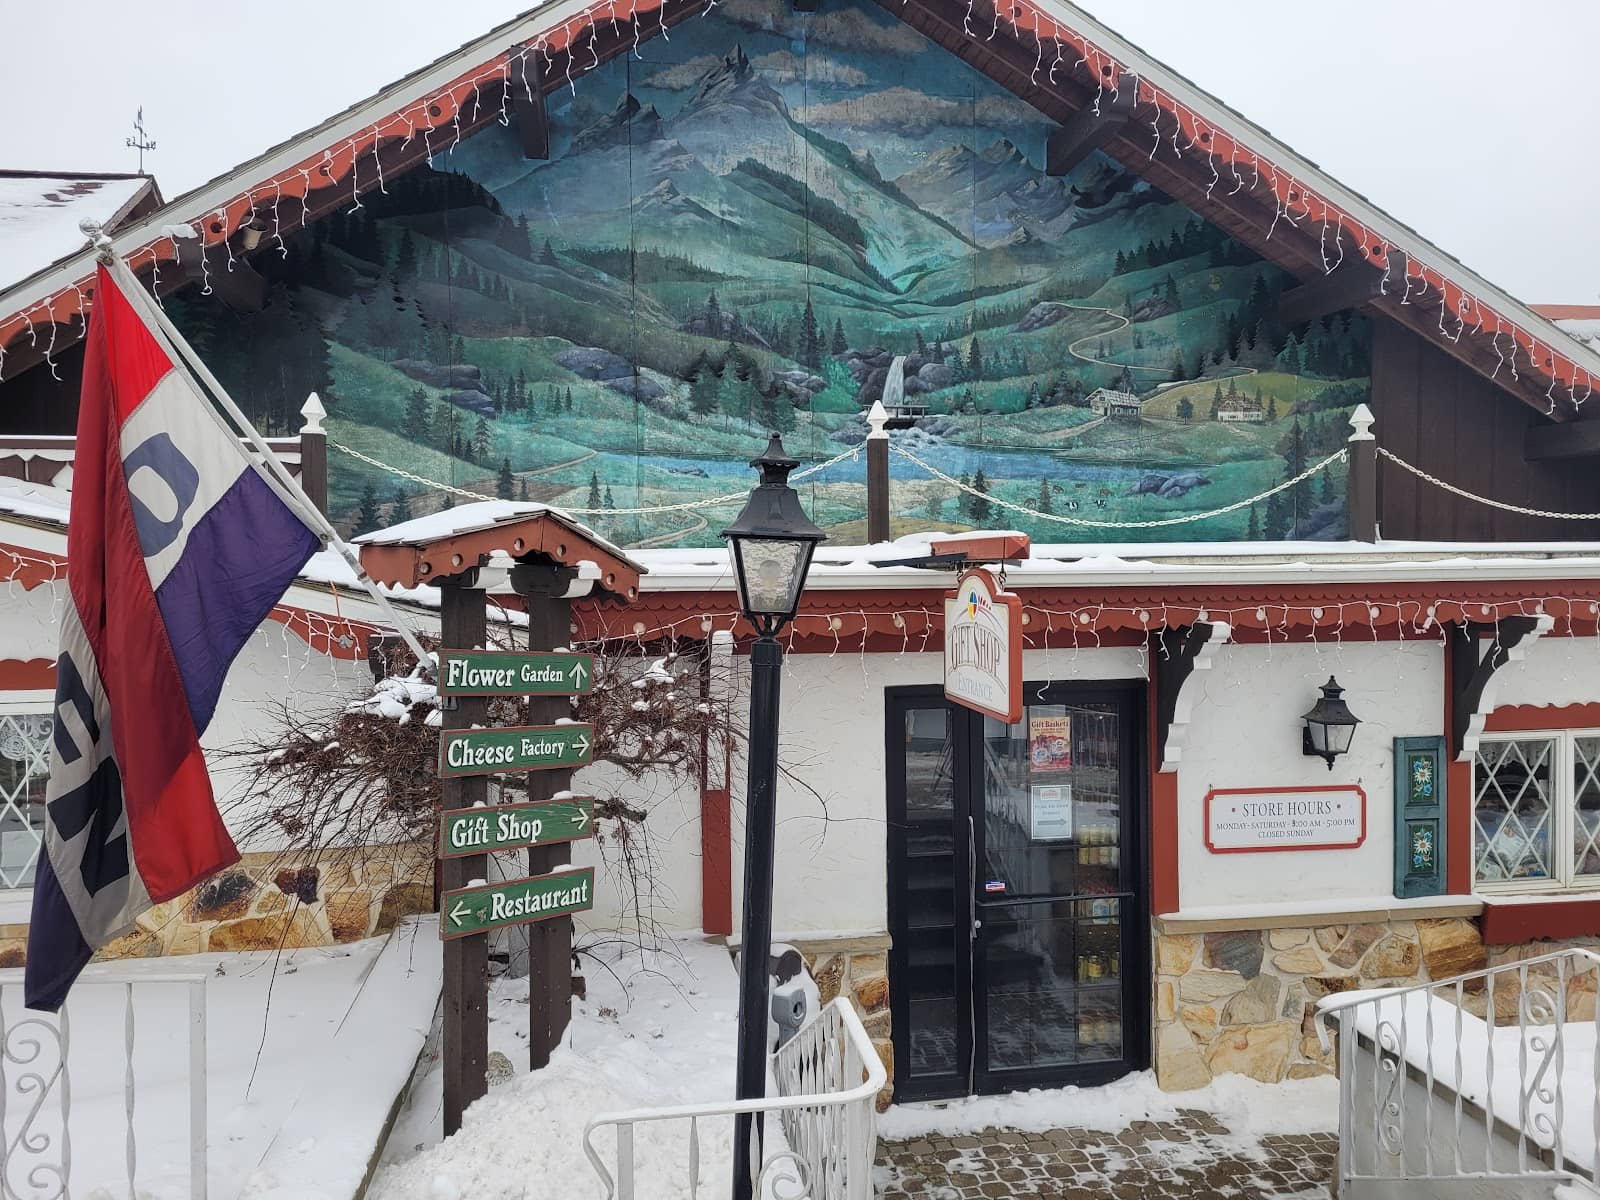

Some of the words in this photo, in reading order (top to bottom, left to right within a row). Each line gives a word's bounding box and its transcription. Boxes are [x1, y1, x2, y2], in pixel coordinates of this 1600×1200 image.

[952, 625, 971, 670] GIFT
[974, 621, 1001, 678] SHOP
[446, 659, 515, 687] Flower
[520, 664, 564, 683] Garden
[1031, 720, 1044, 728] Gift
[1045, 720, 1069, 728] Baskets
[447, 738, 514, 767] Cheese
[520, 737, 565, 758] Factory
[1242, 802, 1284, 817] STORE
[1288, 801, 1332, 816] HOURS
[1326, 818, 1343, 827] 5:00
[1344, 818, 1356, 826] PM
[451, 816, 489, 848] Gift
[496, 813, 542, 843] Shop
[1258, 830, 1285, 839] CLOSED
[1286, 829, 1314, 838] SUNDAY
[490, 879, 588, 921] Restaurant
